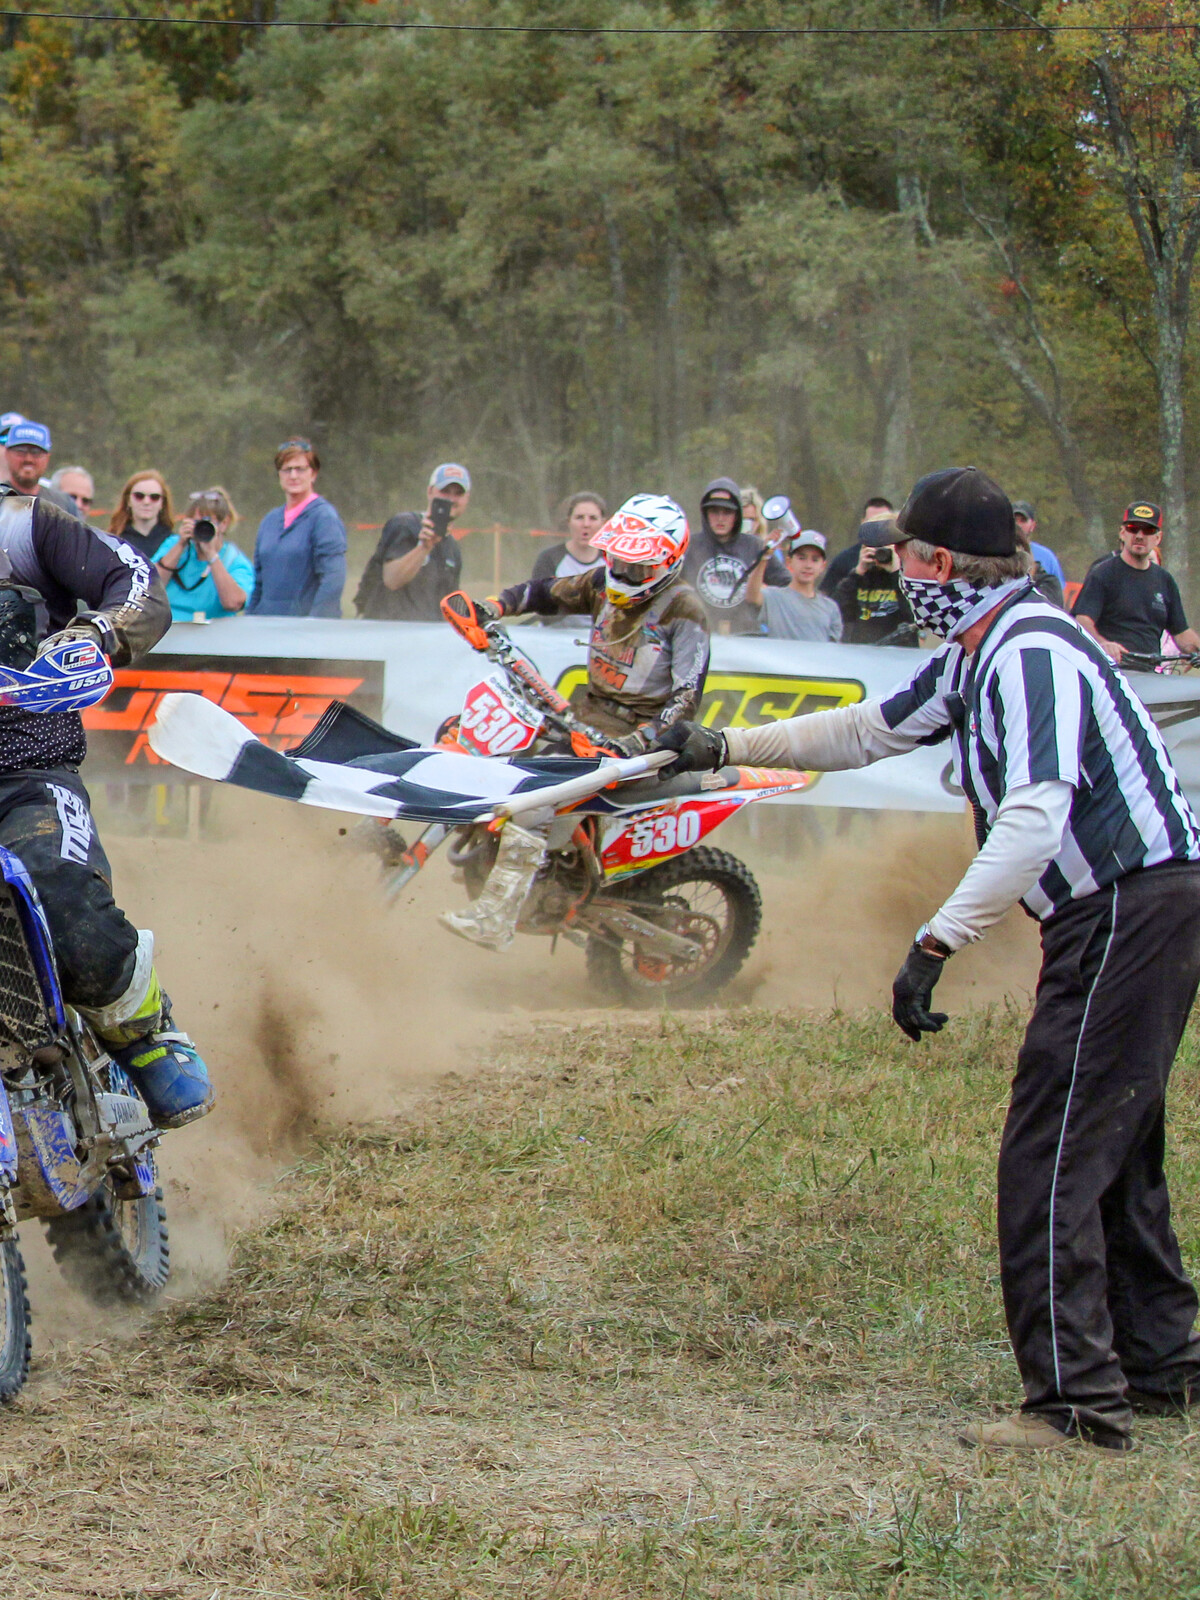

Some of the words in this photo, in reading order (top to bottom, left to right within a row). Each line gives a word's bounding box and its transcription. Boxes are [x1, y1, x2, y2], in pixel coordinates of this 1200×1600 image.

[68, 671, 109, 691] USA
[461, 692, 527, 756] 530
[629, 810, 700, 858] 530
